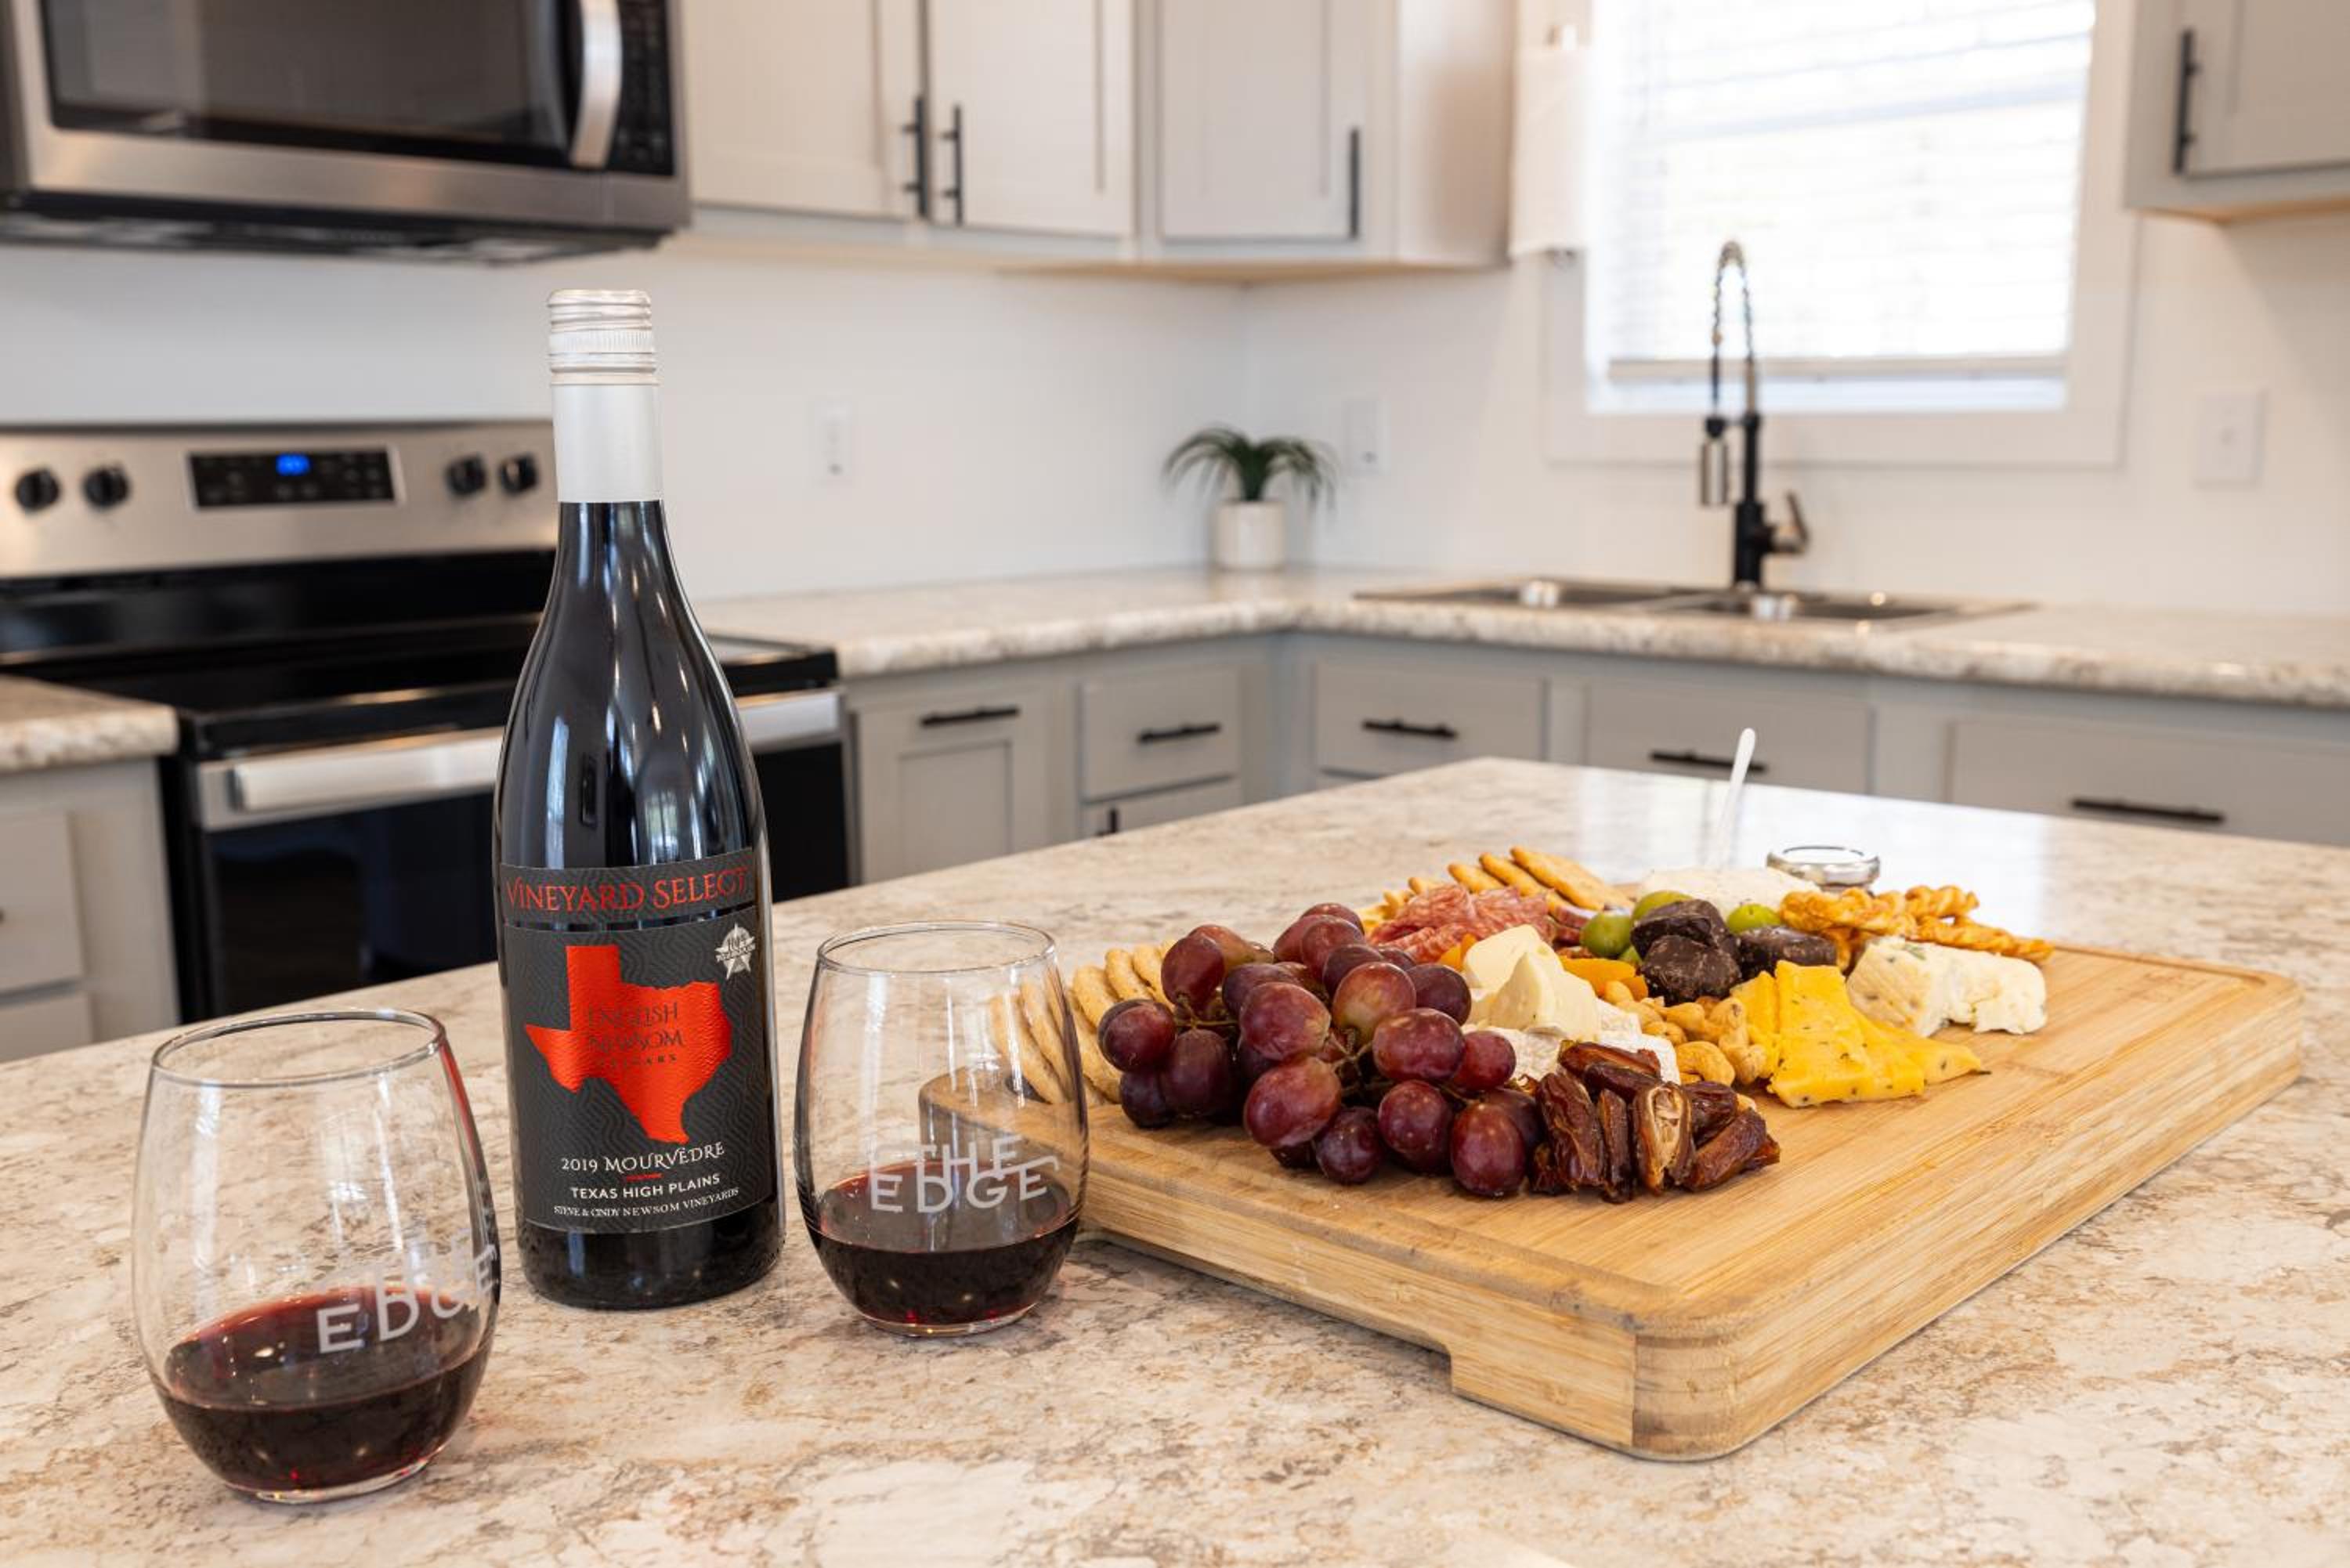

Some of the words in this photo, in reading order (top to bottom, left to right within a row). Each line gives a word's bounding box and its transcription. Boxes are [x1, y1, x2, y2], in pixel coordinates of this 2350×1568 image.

[504, 876, 645, 912] VINEYARD
[653, 865, 750, 909] SELECT
[561, 1158, 598, 1172] 2019
[570, 1187, 618, 1199] TEXAS
[623, 1184, 663, 1198] HIGH
[668, 1172, 721, 1195] PLAINS
[869, 1154, 1060, 1214] EDGE
[582, 1208, 589, 1216] &
[623, 1201, 680, 1217] NEWSOM
[682, 1187, 739, 1209] VINEYARDS
